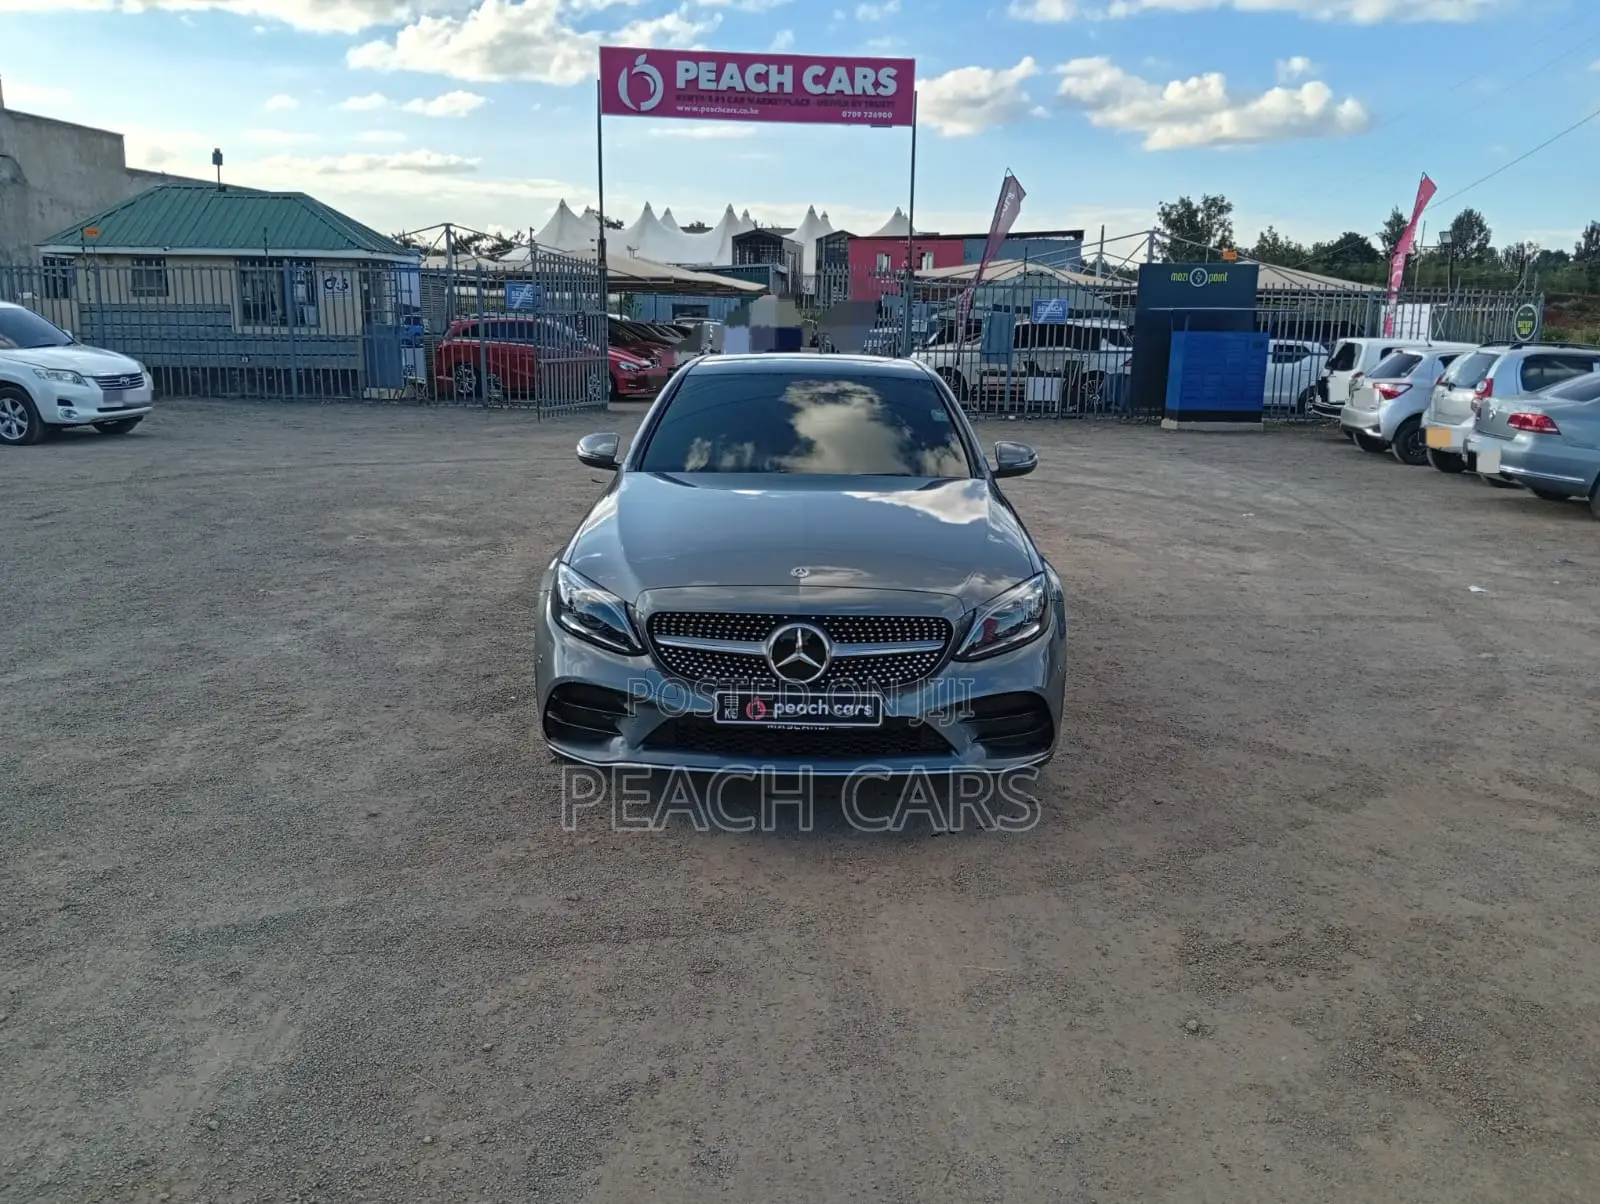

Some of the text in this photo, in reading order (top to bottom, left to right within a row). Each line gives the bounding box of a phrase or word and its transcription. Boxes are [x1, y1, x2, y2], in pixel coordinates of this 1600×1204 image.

[675, 60, 898, 96] PEACH CARS
[773, 699, 873, 719] peach cars
